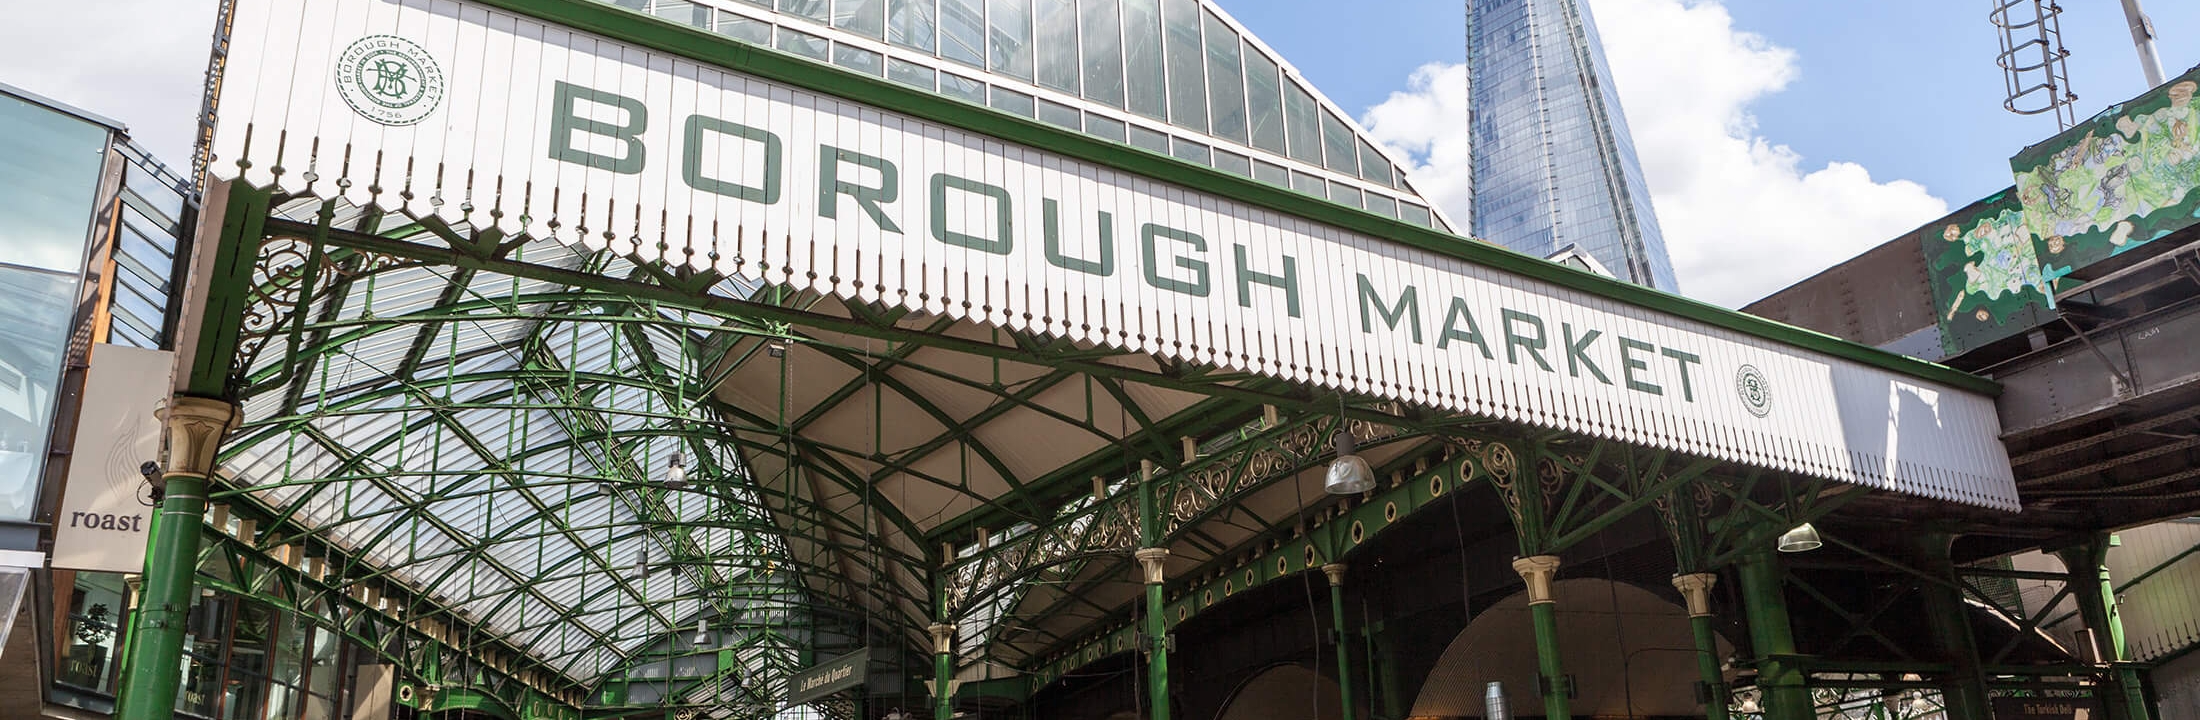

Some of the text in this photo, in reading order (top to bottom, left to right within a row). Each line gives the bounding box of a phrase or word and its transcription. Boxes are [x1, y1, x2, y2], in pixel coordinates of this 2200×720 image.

[343, 40, 437, 101] BOROUGH MARKET
[371, 106, 402, 118] 1756
[549, 80, 1701, 403] BOROUGH MARKET
[70, 509, 142, 532] roast
[70, 659, 97, 677] roast
[184, 690, 206, 706] roast
